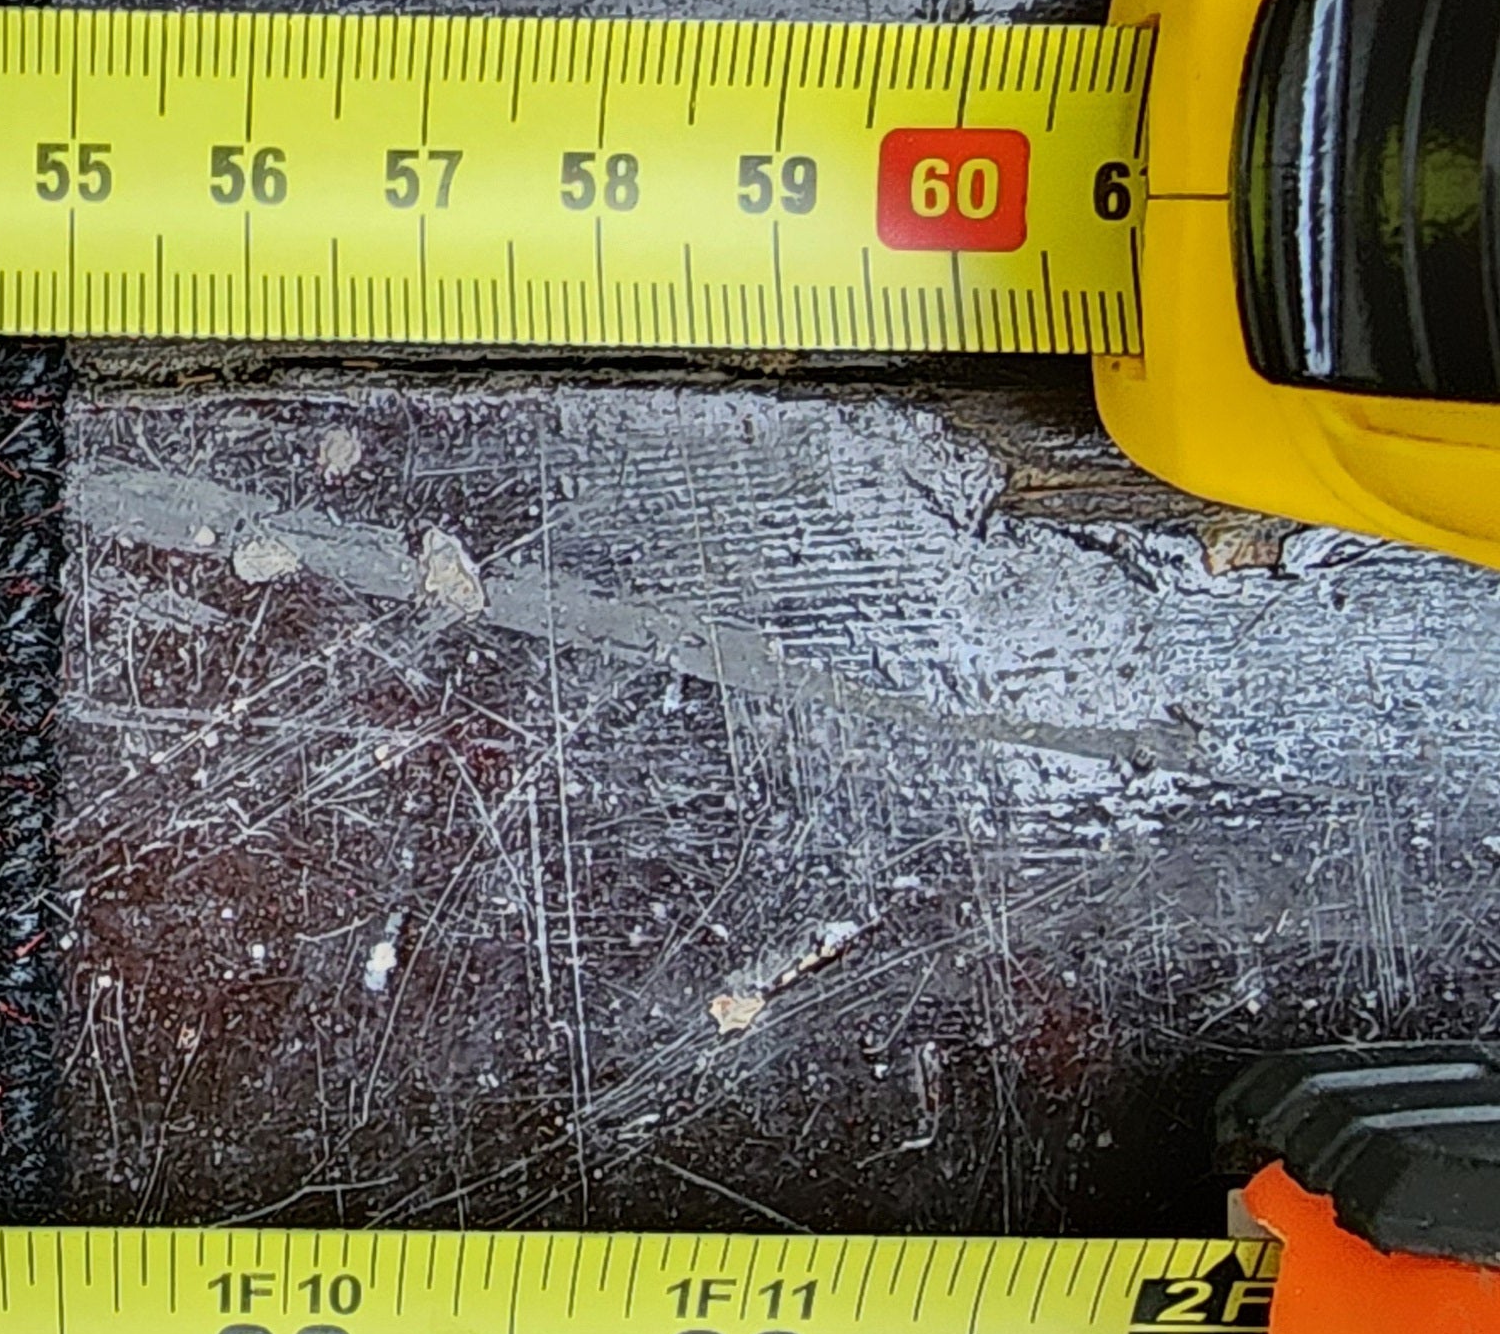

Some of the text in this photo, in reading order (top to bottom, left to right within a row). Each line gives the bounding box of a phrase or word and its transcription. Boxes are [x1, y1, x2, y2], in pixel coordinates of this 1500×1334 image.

[36, 142, 113, 202] 55
[210, 145, 288, 205] 56
[385, 148, 463, 208] 57
[560, 151, 640, 211] 58
[738, 154, 818, 214] 59
[910, 157, 998, 219] 60
[1093, 161, 1148, 220] 6
